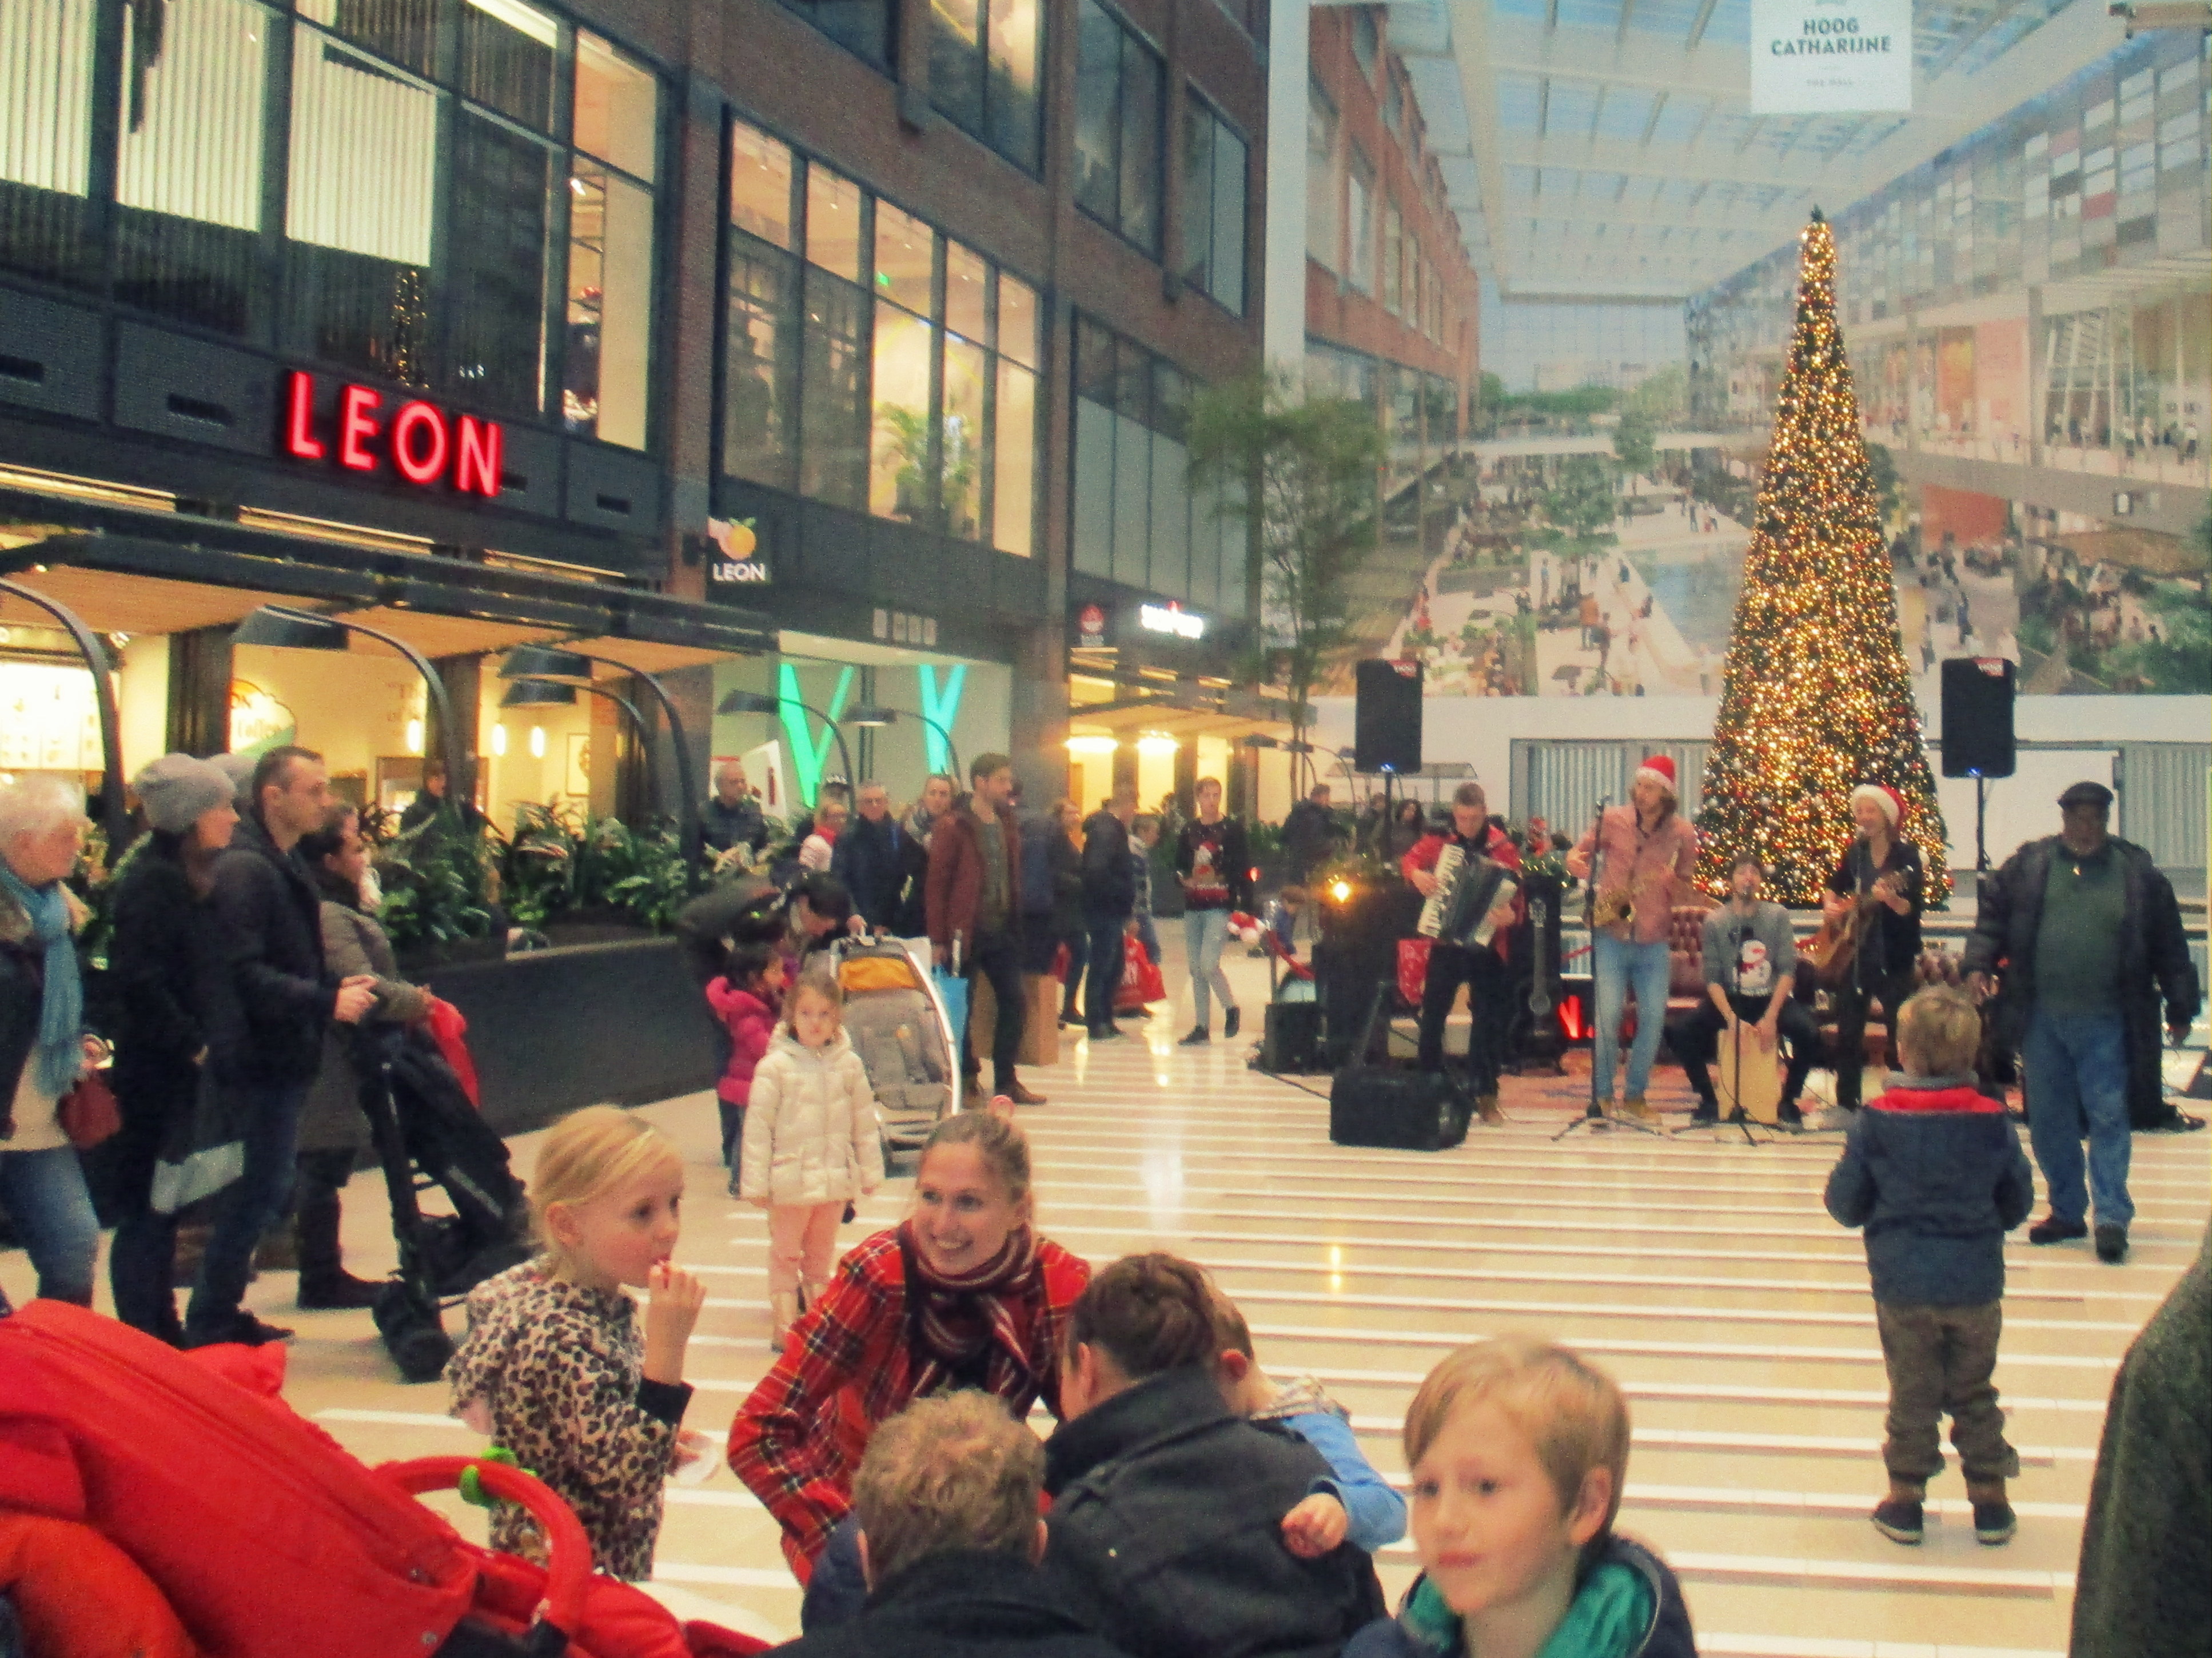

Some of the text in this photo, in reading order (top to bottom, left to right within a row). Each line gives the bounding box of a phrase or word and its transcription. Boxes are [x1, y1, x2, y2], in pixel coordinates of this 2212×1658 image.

[1803, 17, 1859, 35] HOOG
[1771, 35, 1891, 55] CATHARIJNE
[285, 370, 503, 497] LEON
[712, 563, 766, 581] LEON
